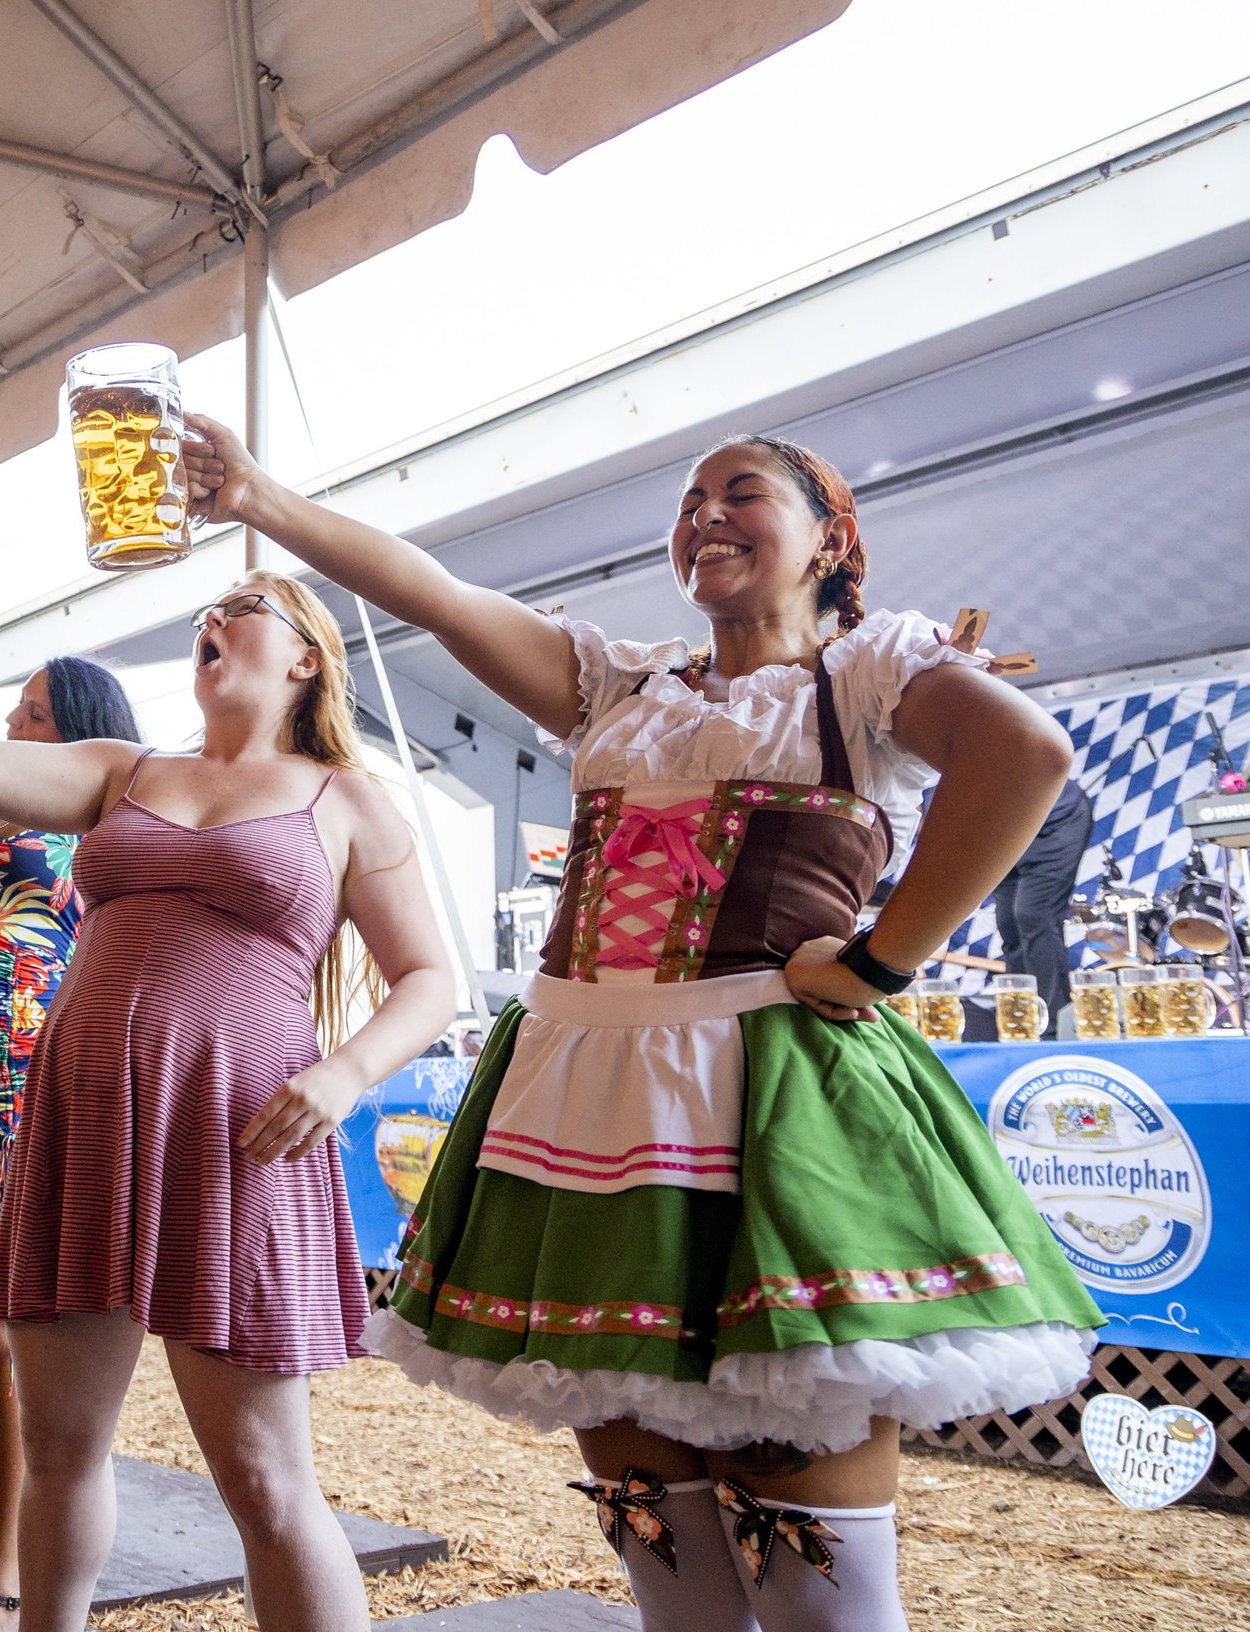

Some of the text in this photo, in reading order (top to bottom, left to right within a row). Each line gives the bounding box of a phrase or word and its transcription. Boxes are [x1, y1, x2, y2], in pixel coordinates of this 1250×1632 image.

[1007, 1102, 1022, 1121] THE
[1063, 1071, 1108, 1088] OLDEST
[1107, 1082, 1158, 1124] BREWERY
[1007, 1155, 1191, 1195] Weihenstephan
[1113, 1249, 1178, 1278] BAVARICUM
[1116, 1415, 1174, 1457] bier
[1121, 1448, 1175, 1485] here
